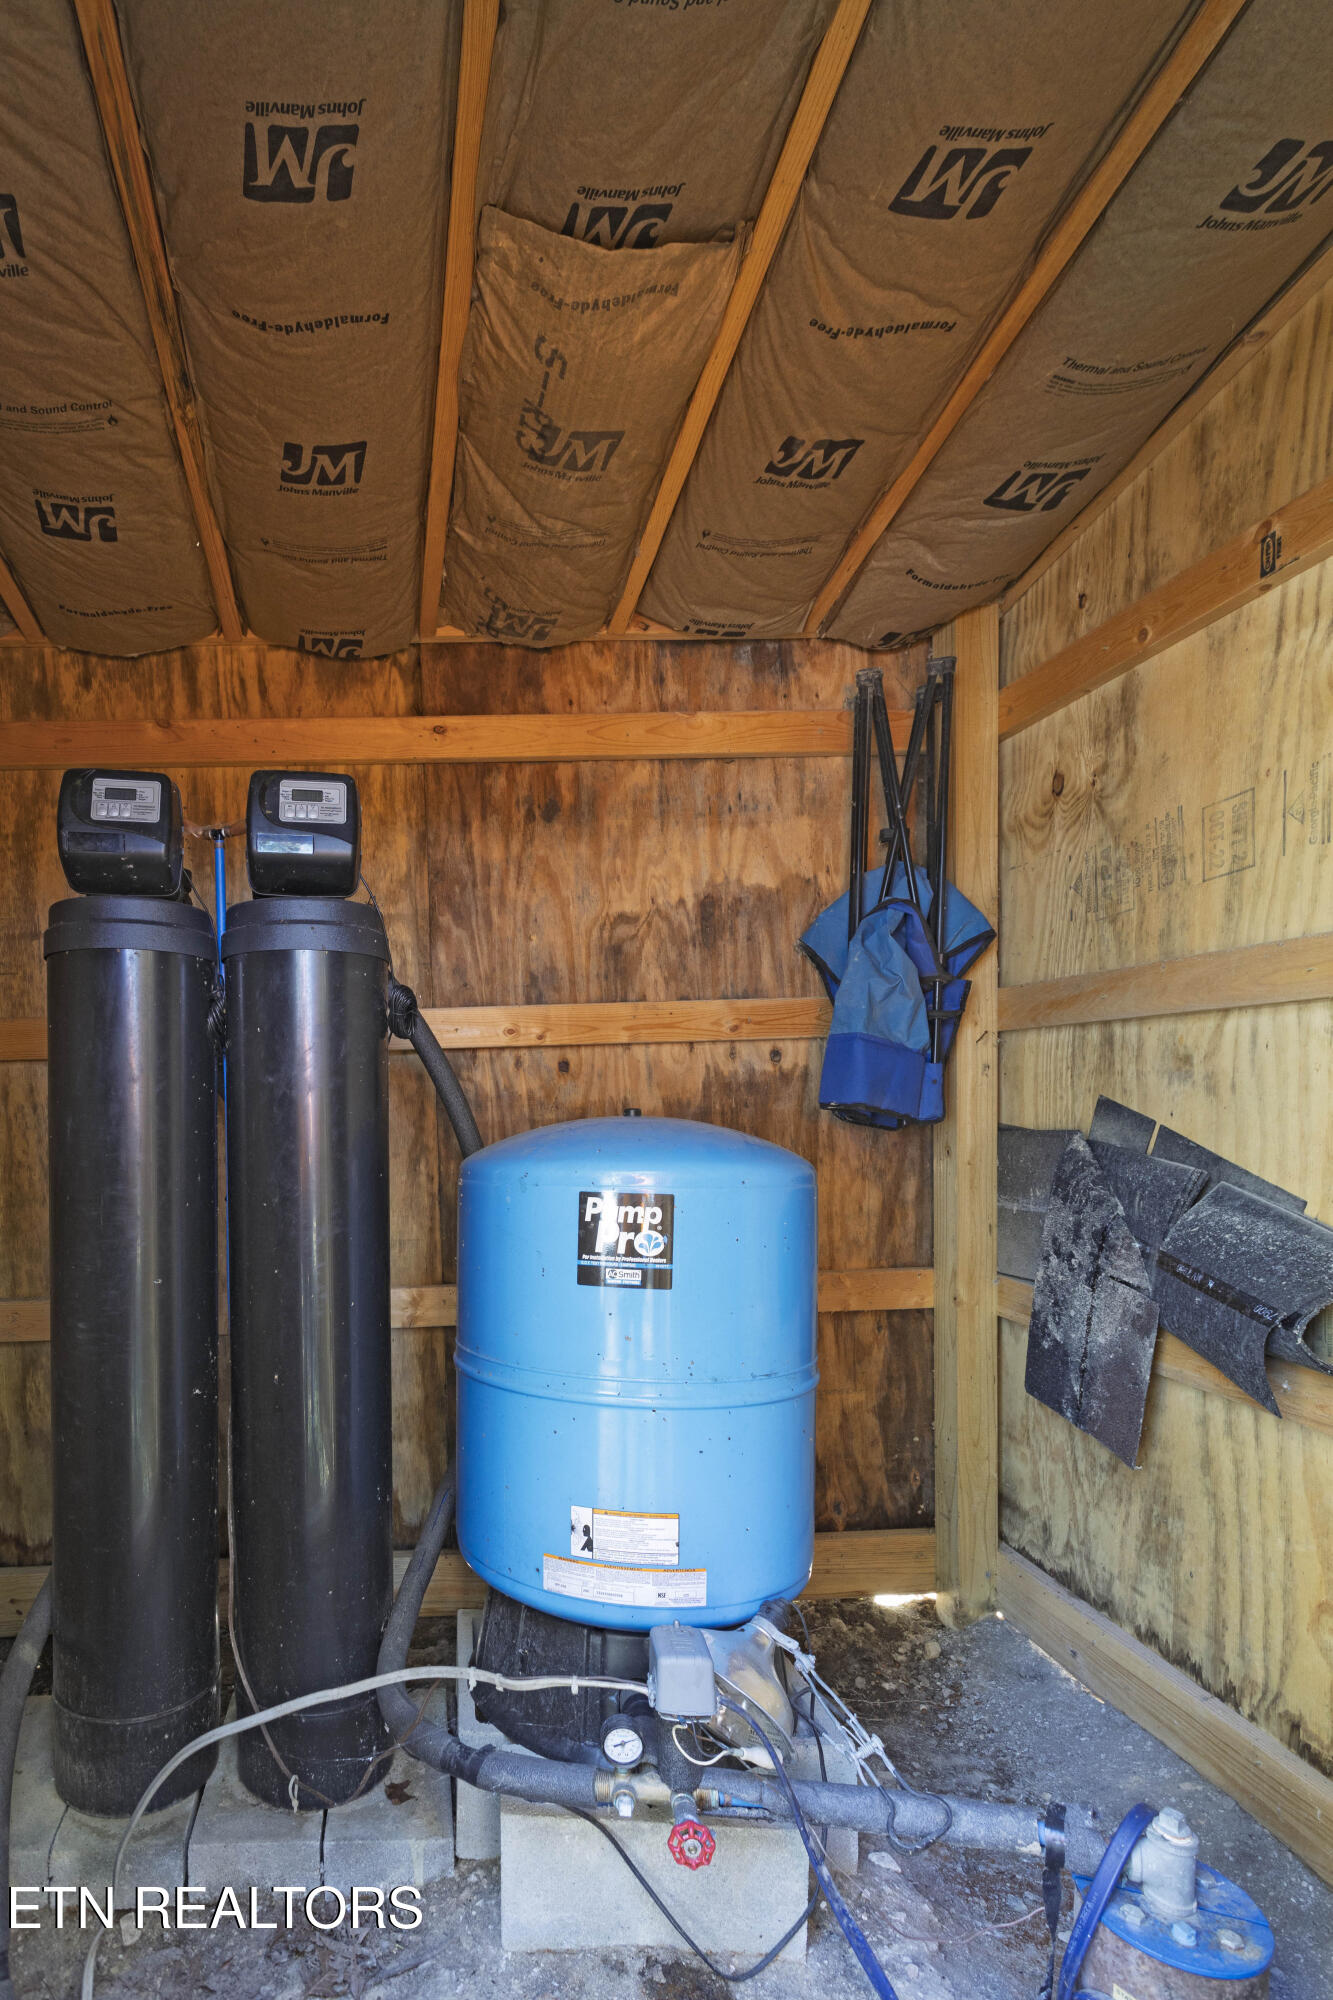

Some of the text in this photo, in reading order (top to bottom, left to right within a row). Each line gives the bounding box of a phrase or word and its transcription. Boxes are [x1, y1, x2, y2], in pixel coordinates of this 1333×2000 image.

[245, 98, 367, 119] Johns Manville
[939, 122, 1055, 142] Johns Manville
[243, 122, 360, 203] JM
[576, 182, 687, 201] Johns Manville
[888, 145, 1034, 220] JM
[1195, 215, 1244, 231] Johns
[530, 281, 680, 315] Formaldehyde-Free
[231, 310, 390, 336] Formaldehyde-Free
[809, 318, 958, 340] Formaldehyde-Free
[1062, 356, 1109, 375] Thermal
[1109, 365, 1131, 375] and
[1132, 355, 1171, 373] Sound
[6, 400, 113, 414] and Sound Control
[280, 440, 368, 486] JM
[764, 435, 866, 480] JM
[276, 484, 360, 497] Johns Manville
[753, 476, 785, 488] Johns
[982, 467, 1092, 512] JM
[32, 488, 116, 504] Johns Manville
[34, 499, 119, 542] JM
[58, 603, 173, 618] Formaldehyde-Free
[585, 1196, 662, 1231] Pmp
[619, 1271, 640, 1280] Smith
